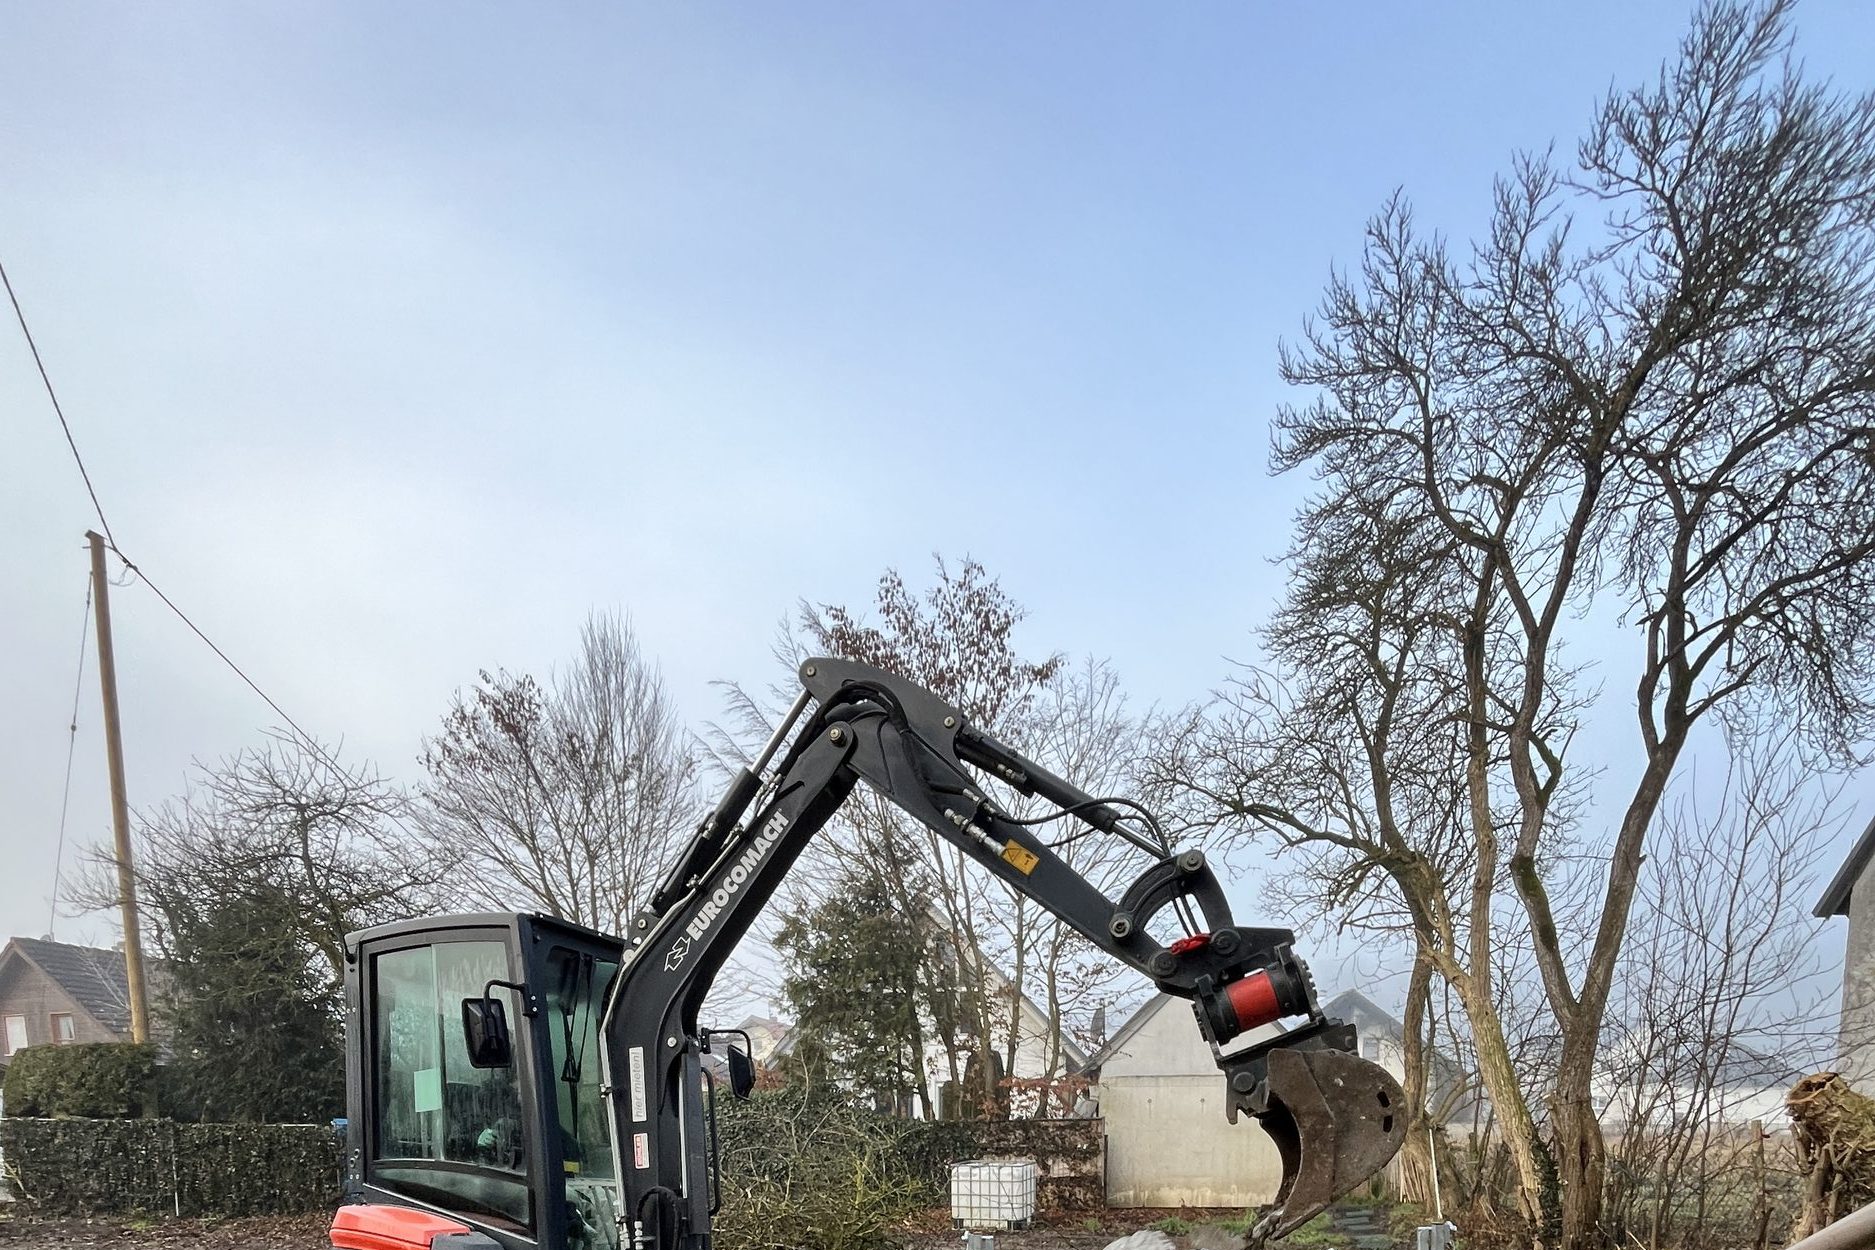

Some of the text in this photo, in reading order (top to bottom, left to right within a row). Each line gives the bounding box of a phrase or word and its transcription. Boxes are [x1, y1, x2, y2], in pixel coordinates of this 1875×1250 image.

[686, 811, 789, 942] EUROCOMACH
[631, 1051, 644, 1118] hier mieten!
